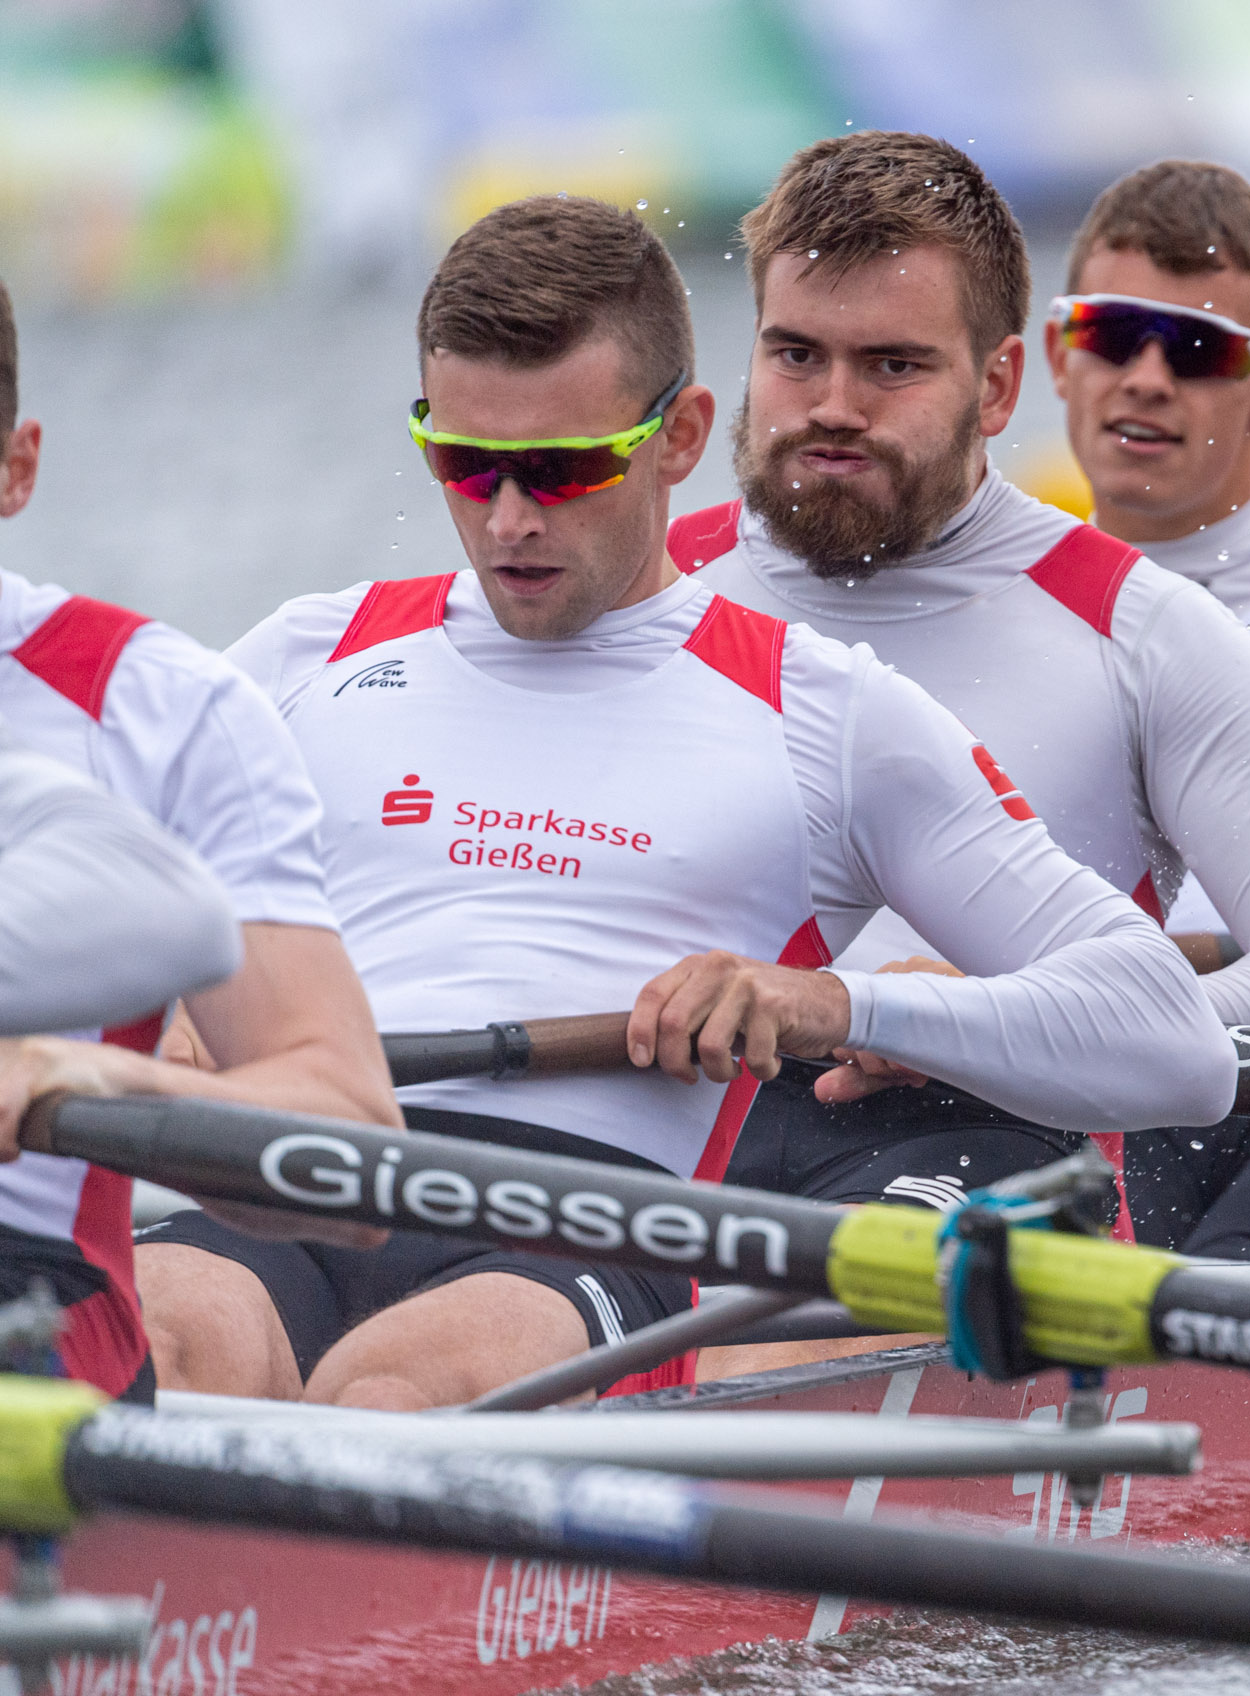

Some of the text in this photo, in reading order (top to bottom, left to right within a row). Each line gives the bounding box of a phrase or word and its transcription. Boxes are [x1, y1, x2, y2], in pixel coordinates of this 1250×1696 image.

[453, 801, 653, 854] Sparkasse
[448, 839, 582, 878] Gießen
[259, 1133, 790, 1277] Giessen
